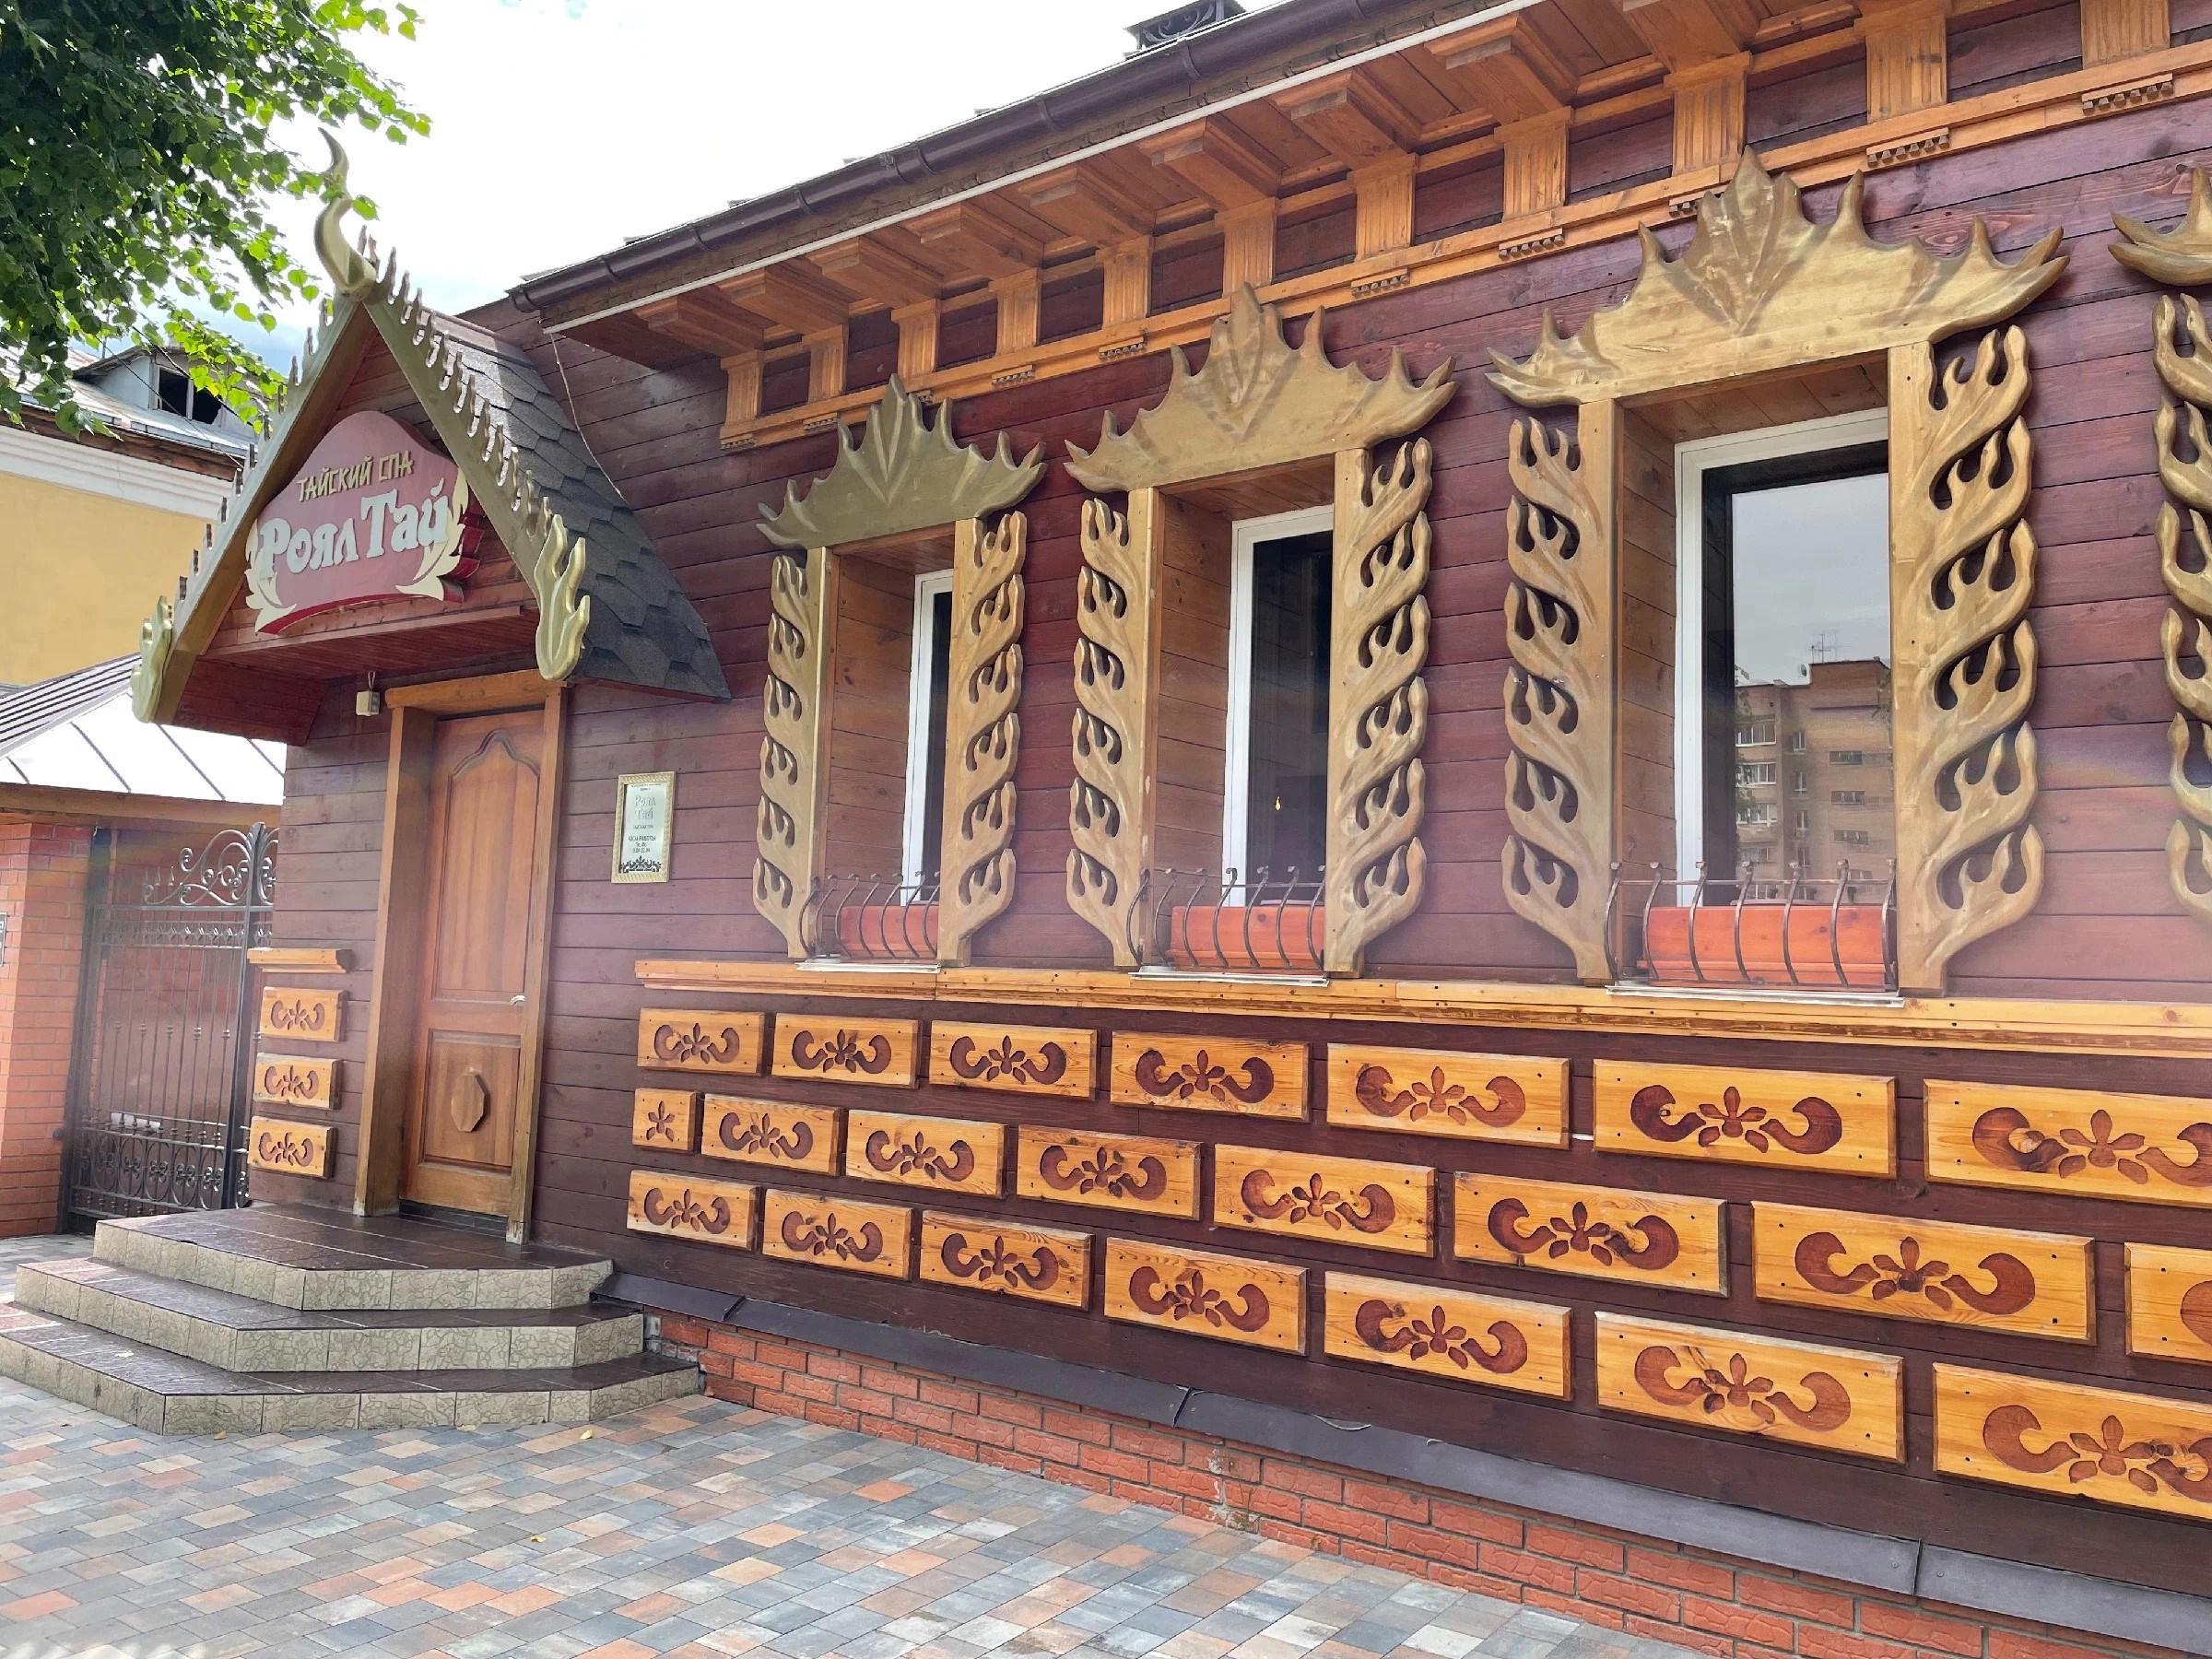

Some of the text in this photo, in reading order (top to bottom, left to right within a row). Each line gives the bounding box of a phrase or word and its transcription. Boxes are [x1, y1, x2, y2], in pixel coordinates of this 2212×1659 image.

[297, 450, 415, 502] ТАЙСКИЙ СПА
[259, 477, 449, 581] Роял Тай
